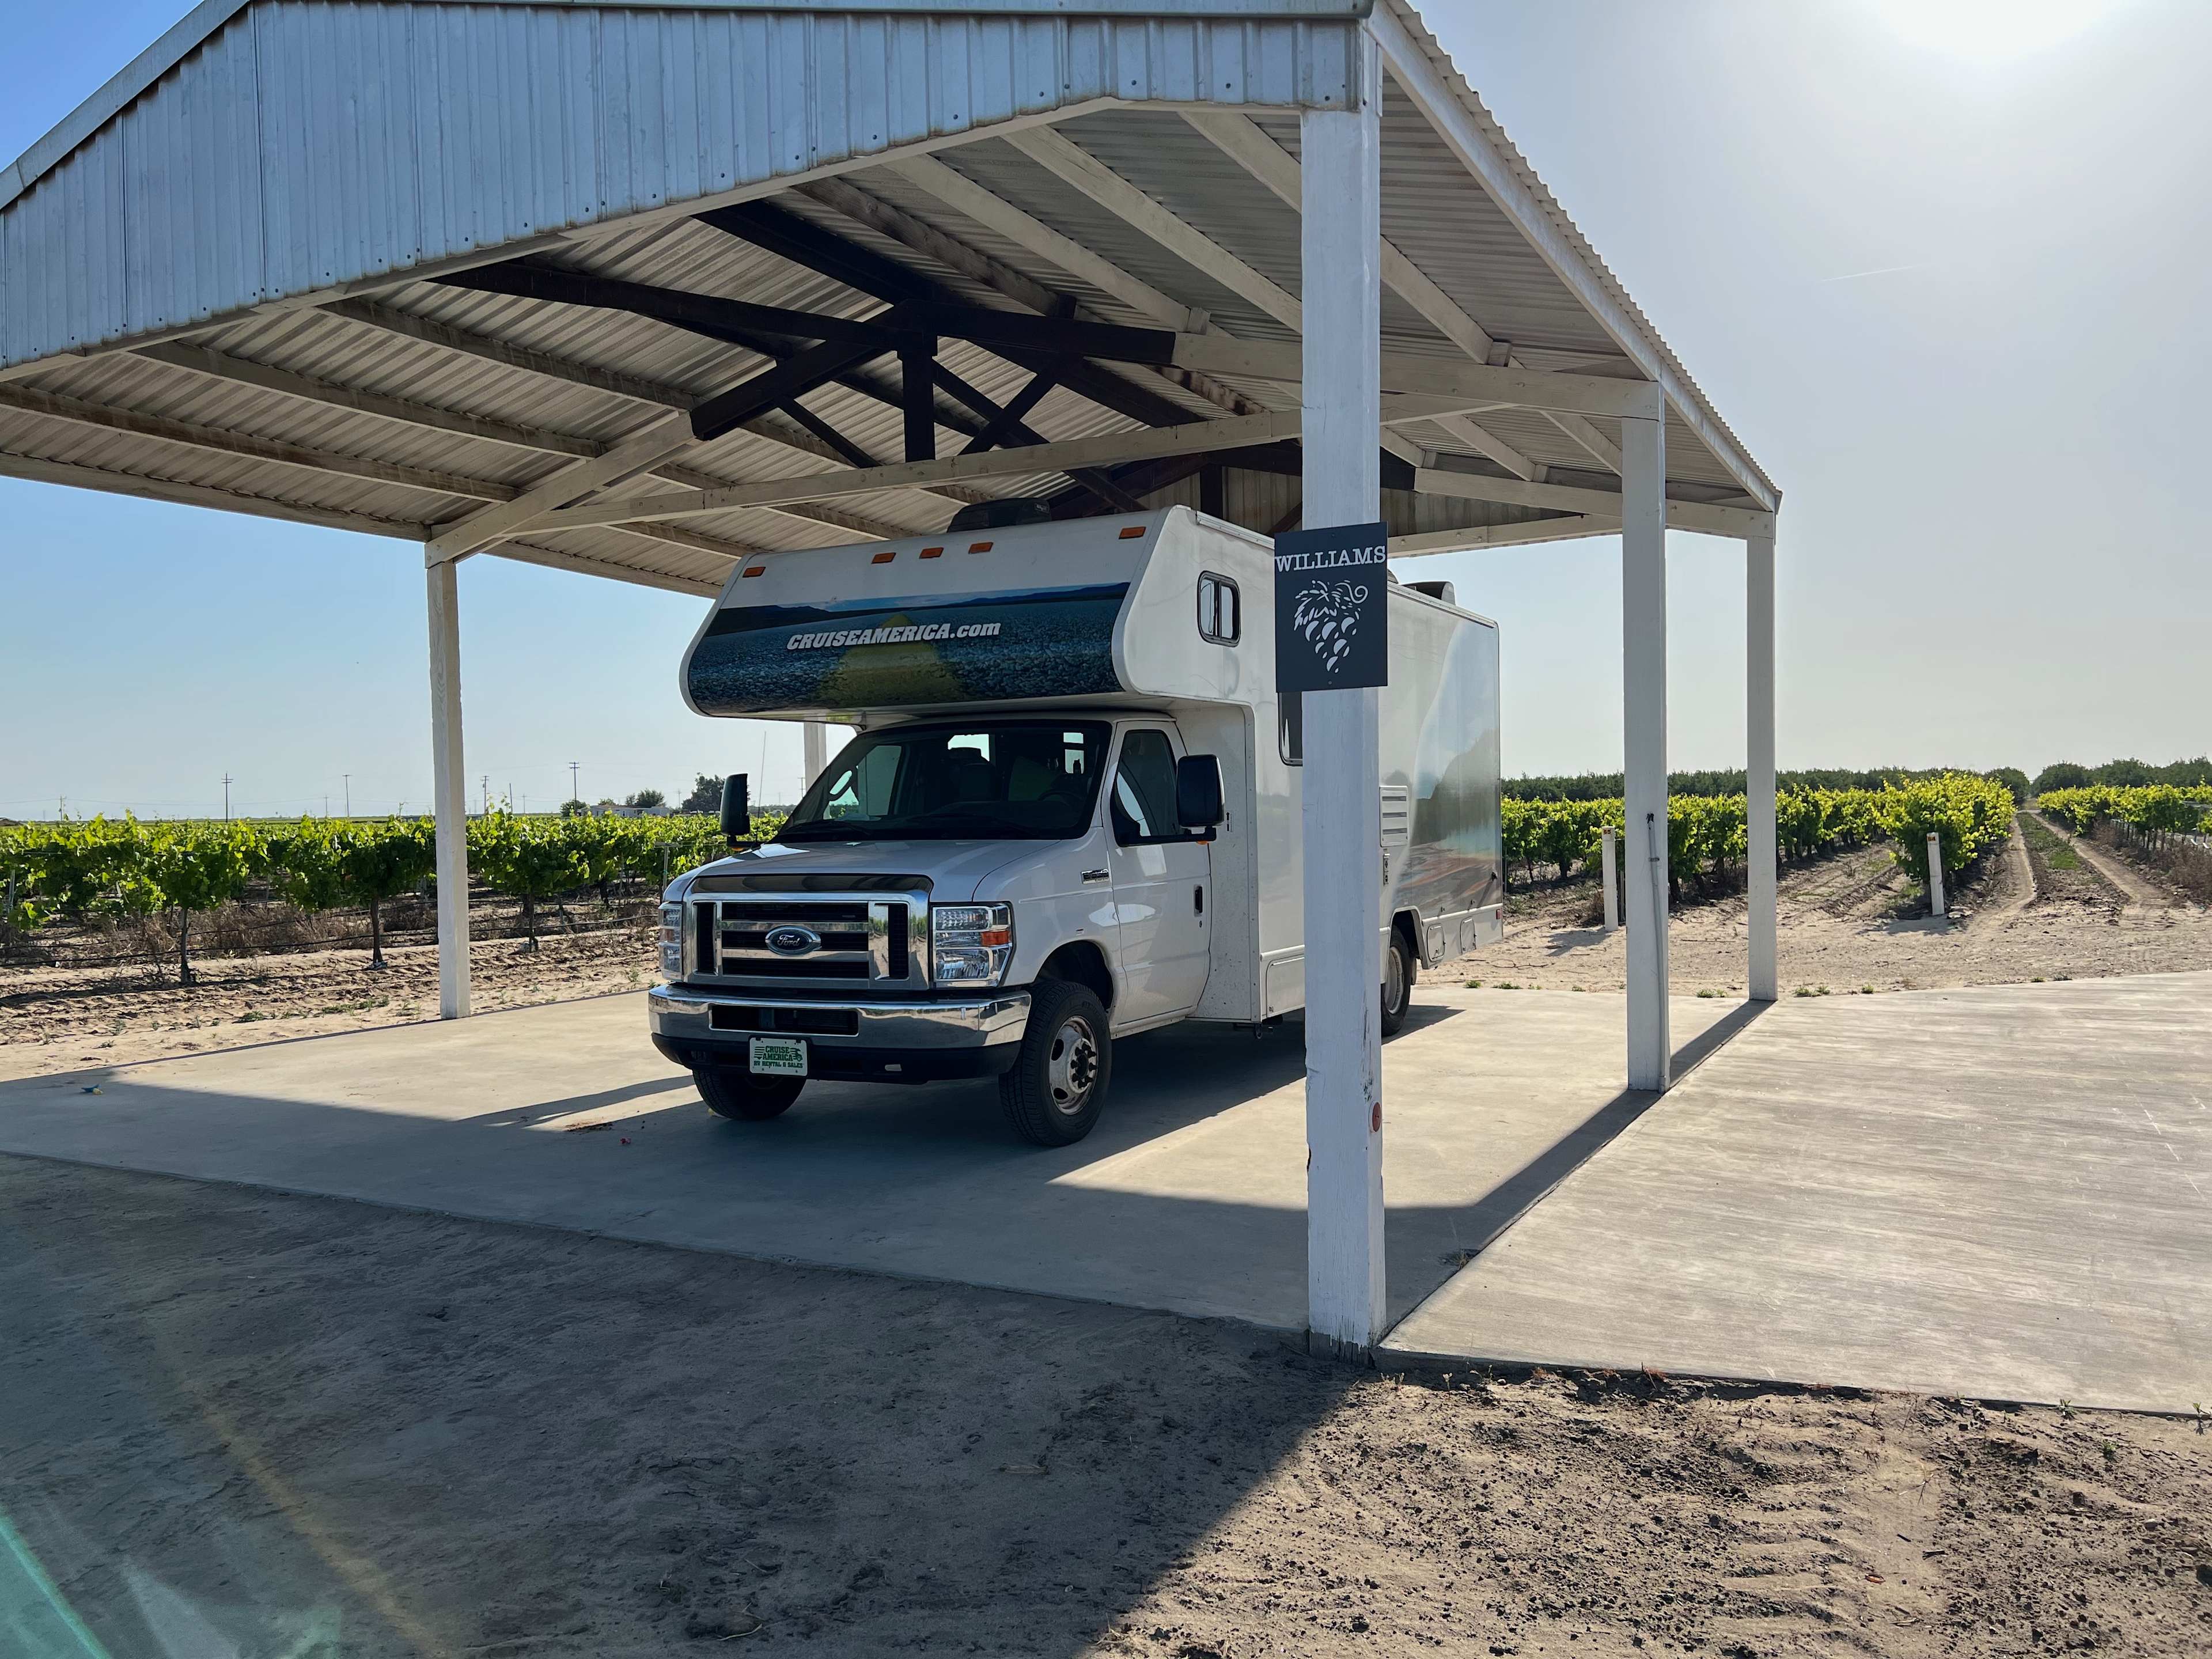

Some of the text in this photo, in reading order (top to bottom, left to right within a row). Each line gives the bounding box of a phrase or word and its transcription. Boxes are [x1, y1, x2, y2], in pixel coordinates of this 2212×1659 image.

[1275, 546, 1386, 572] WILLIAMS
[786, 622, 1001, 650] CRUISEAMERICA.com
[777, 934, 801, 946] Ford
[765, 1046, 790, 1054] CRUISE
[763, 1053, 793, 1061] AMERICA
